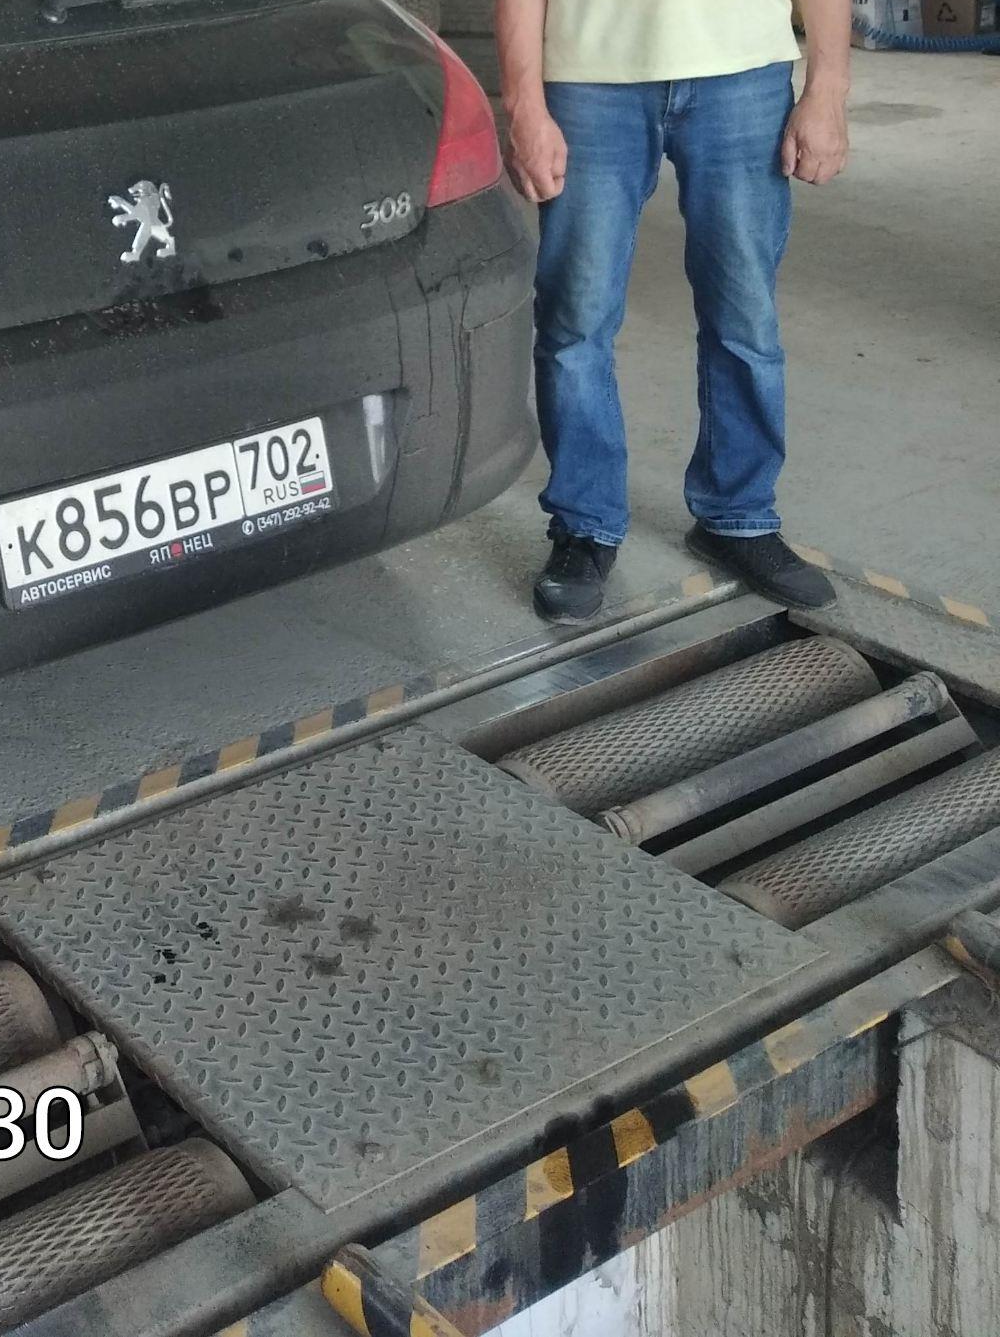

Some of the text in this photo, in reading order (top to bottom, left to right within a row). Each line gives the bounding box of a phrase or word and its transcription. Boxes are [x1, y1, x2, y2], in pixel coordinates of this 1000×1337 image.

[361, 193, 412, 232] 308
[239, 428, 317, 490] 702
[263, 481, 299, 504] RUS
[20, 564, 112, 603] АВТОСЕРВИС
[257, 512, 282, 532] (347)
